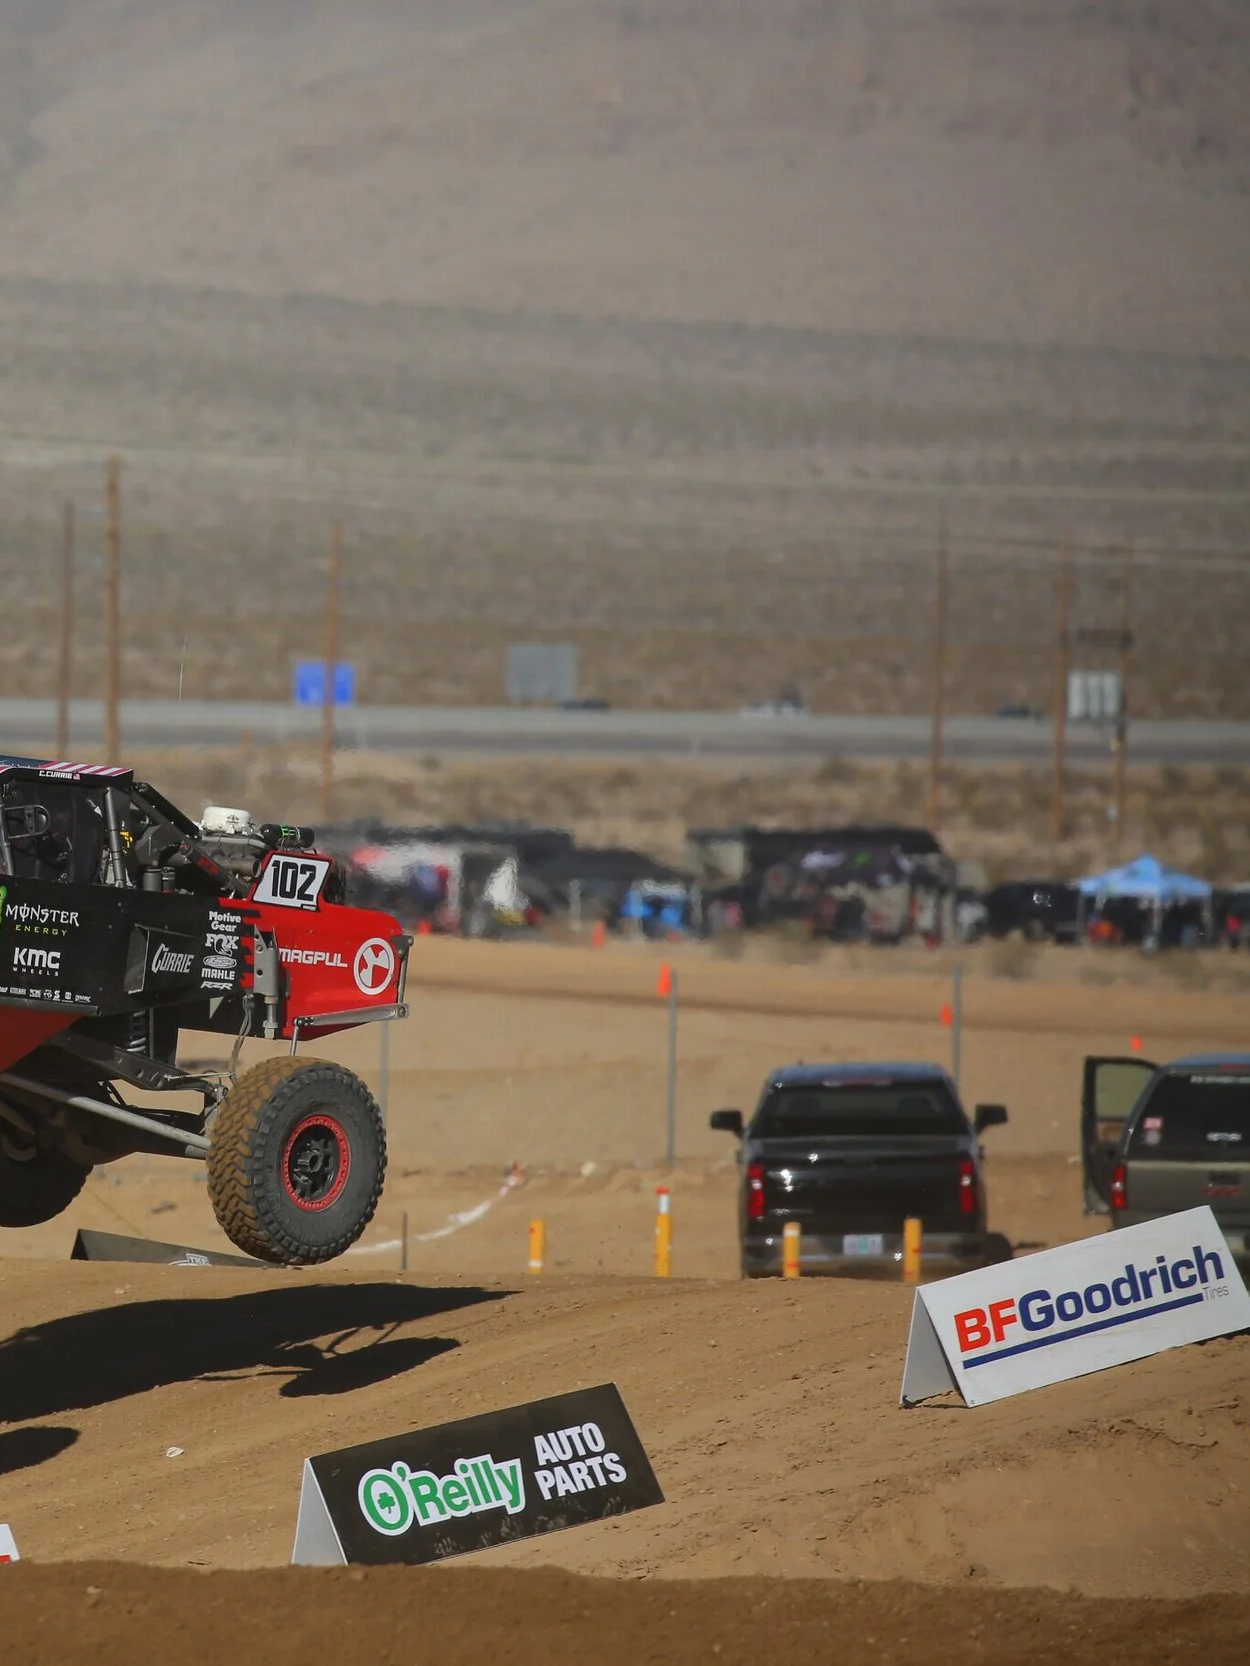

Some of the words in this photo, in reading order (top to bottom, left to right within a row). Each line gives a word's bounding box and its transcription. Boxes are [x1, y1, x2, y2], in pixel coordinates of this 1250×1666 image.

[271, 860, 317, 902] 102
[6, 903, 79, 927] MONSTER
[209, 911, 241, 923] Motive
[211, 921, 237, 932] Gear
[15, 924, 67, 936] ENERGY
[205, 933, 239, 957] FOX
[13, 947, 61, 969] KMC
[279, 948, 348, 968] MAGPUL
[201, 968, 236, 981] MAHLE
[954, 1245, 1225, 1353] BFGoodrich
[1202, 1285, 1229, 1300] Tires
[533, 1422, 606, 1466] AUTO
[534, 1453, 627, 1501] PARTS
[359, 1454, 526, 1536] O'Reilly
